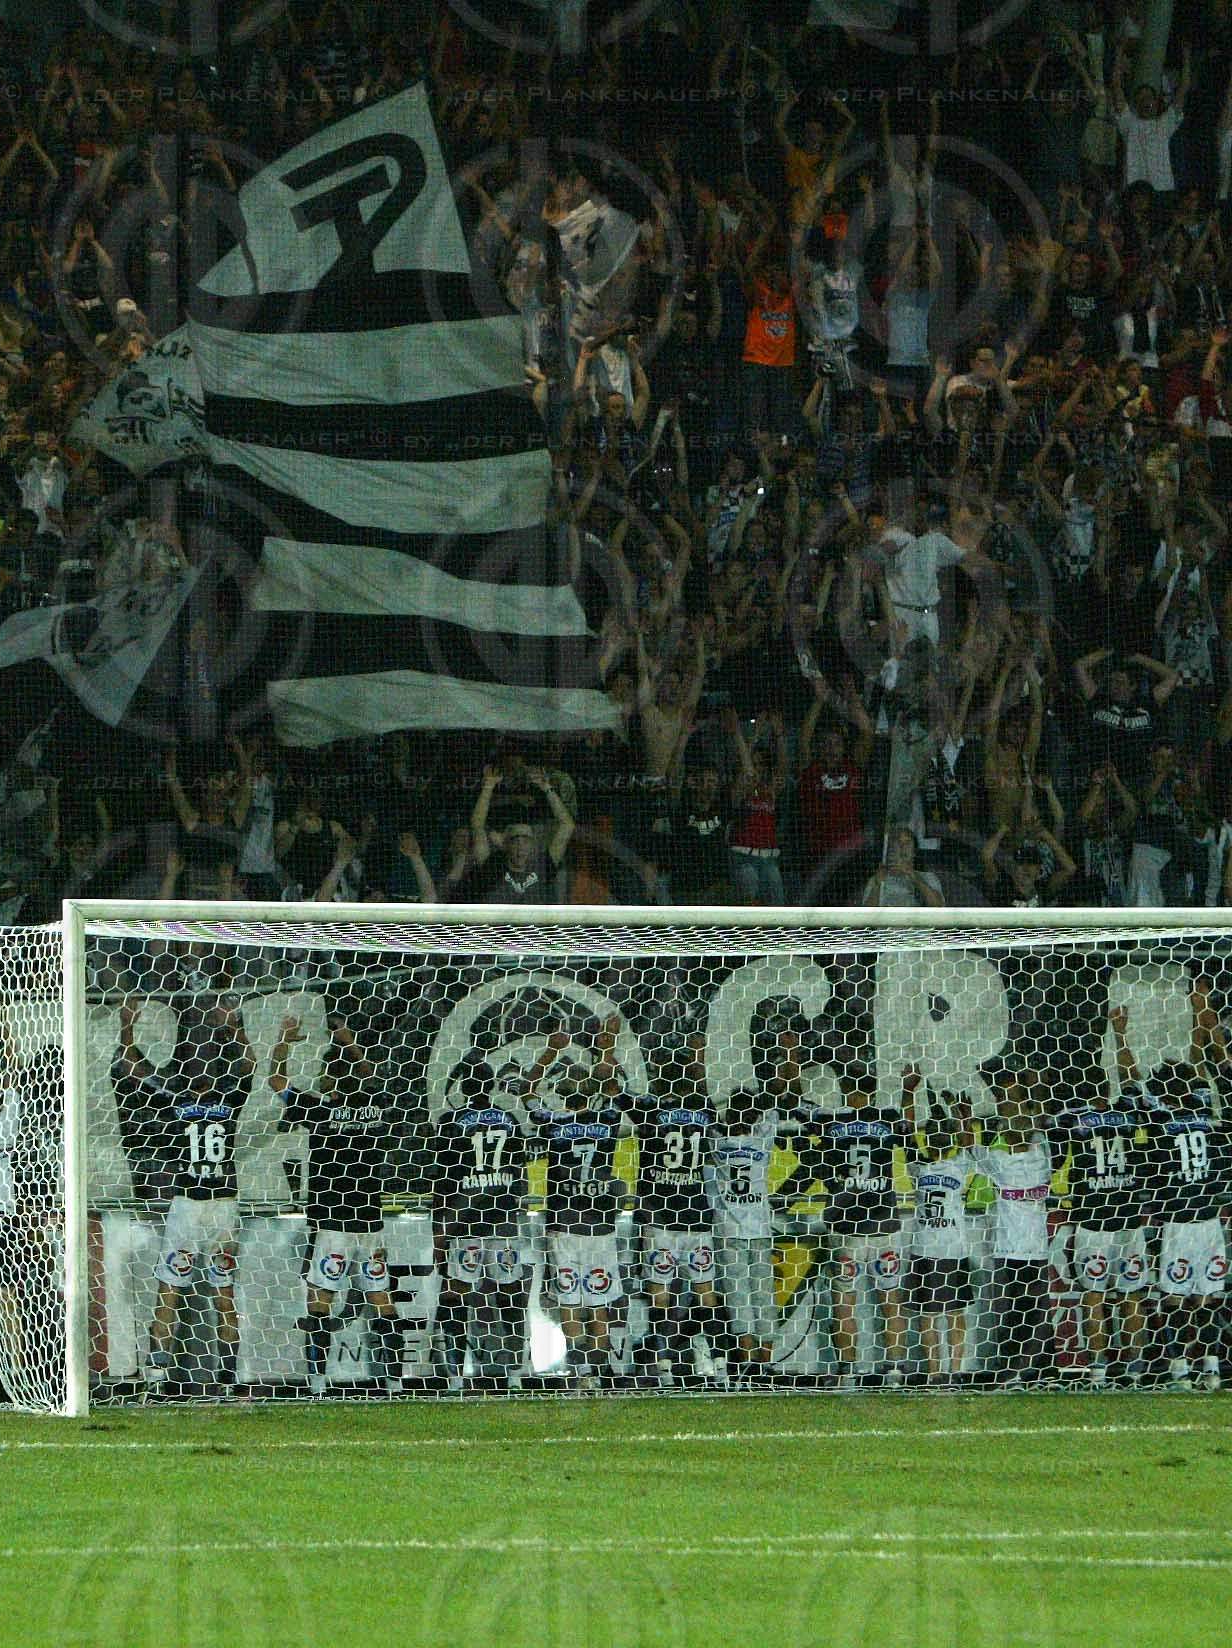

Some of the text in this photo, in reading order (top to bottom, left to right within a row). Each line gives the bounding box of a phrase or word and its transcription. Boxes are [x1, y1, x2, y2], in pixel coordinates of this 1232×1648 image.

[184, 1122, 226, 1163] 16
[470, 1128, 508, 1172] 17
[572, 1142, 597, 1184] 7
[663, 1131, 702, 1172] 31
[848, 1143, 872, 1179] 5
[1089, 1135, 1127, 1174] 14
[1173, 1130, 1209, 1171] 19
